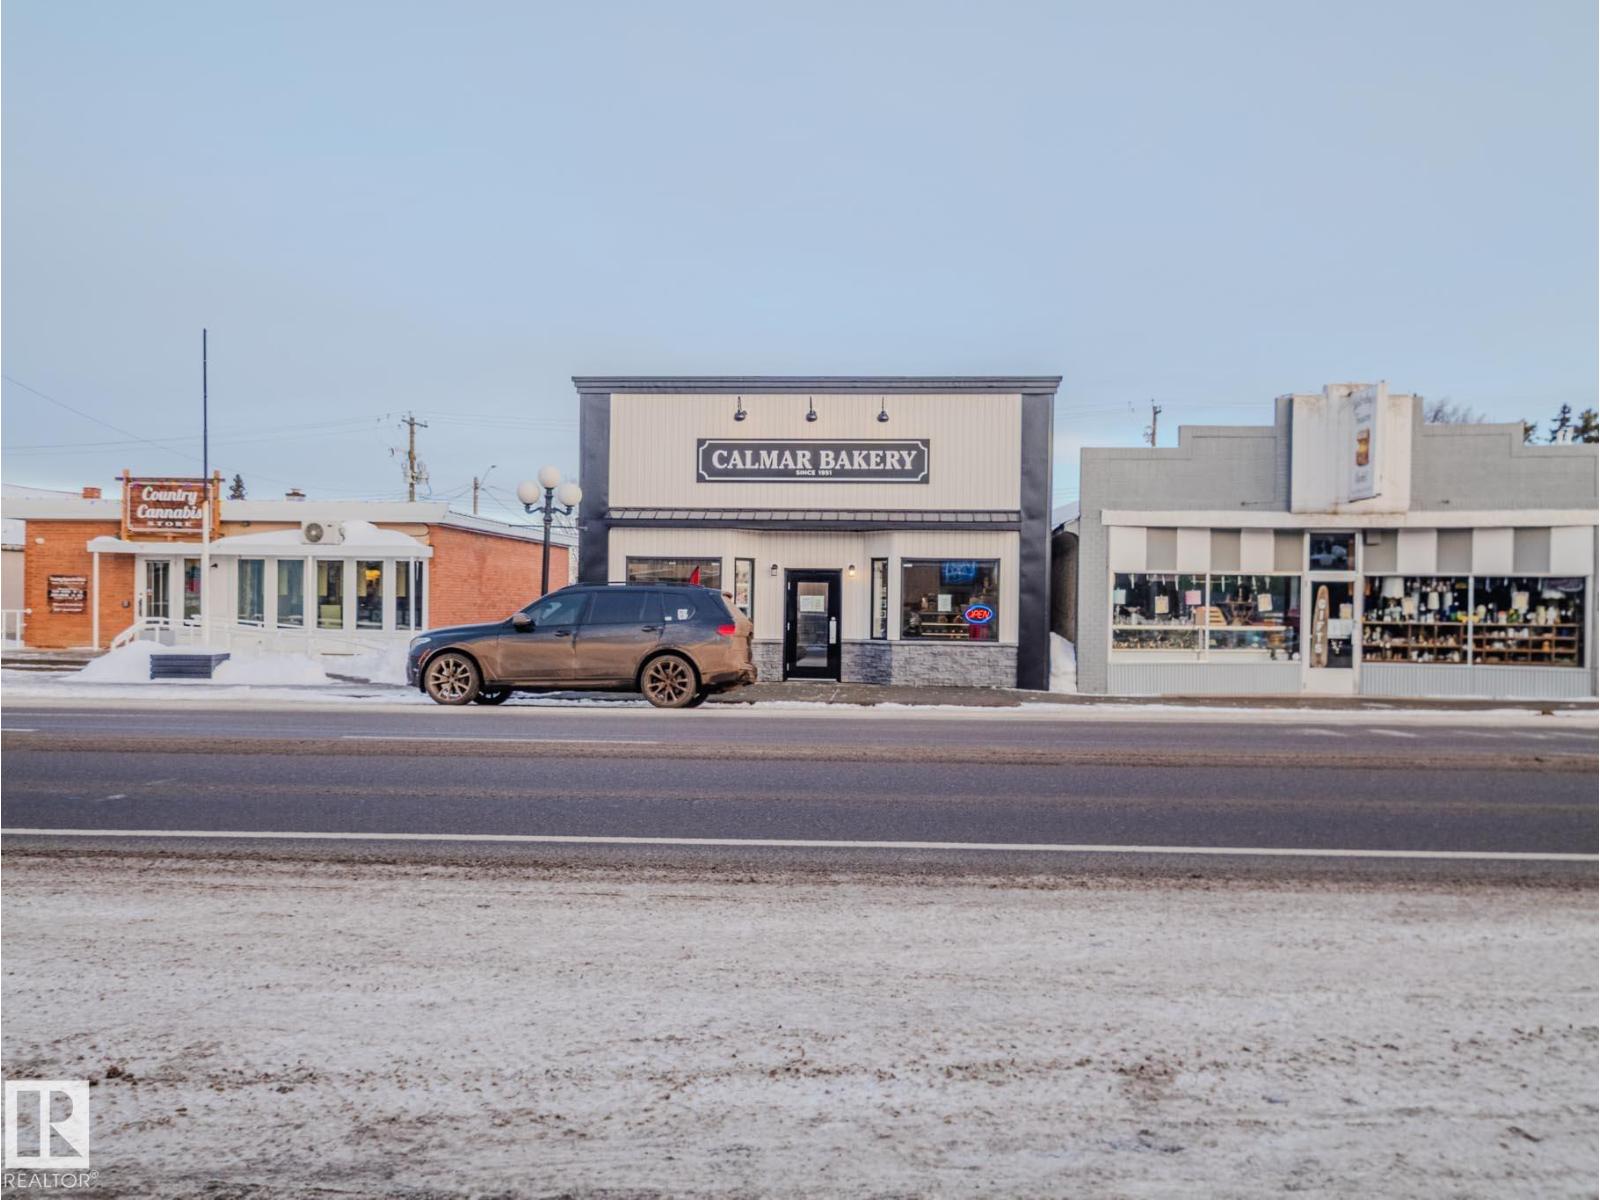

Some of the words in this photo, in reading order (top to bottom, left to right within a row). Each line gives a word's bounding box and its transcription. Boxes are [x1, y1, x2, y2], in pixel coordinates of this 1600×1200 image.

[711, 449, 813, 470] CALMAR
[819, 449, 918, 470] BAKERY
[142, 486, 198, 506] Country
[136, 504, 203, 519] Cannabis
[147, 520, 193, 528] STORE
[967, 608, 990, 620] OPEN
